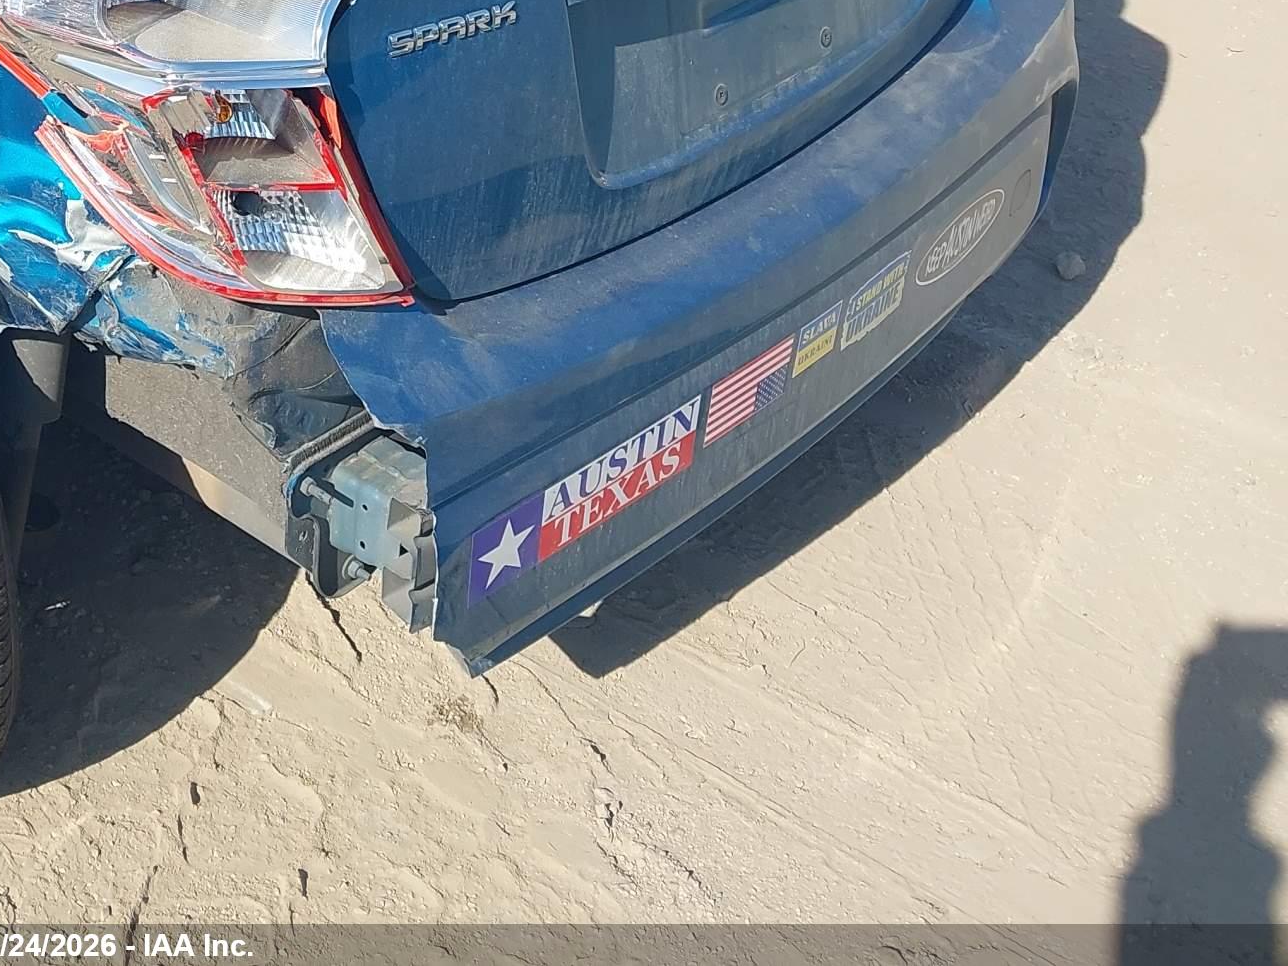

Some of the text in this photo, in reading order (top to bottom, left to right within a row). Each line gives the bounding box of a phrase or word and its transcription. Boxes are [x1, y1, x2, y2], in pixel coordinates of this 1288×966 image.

[387, 0, 517, 58] SPARK
[845, 281, 902, 343] UKRAINE
[855, 280, 882, 312] STAND
[802, 311, 836, 345] SLAVA
[547, 399, 701, 519] AUSTIN
[554, 441, 682, 548] TEXAS
